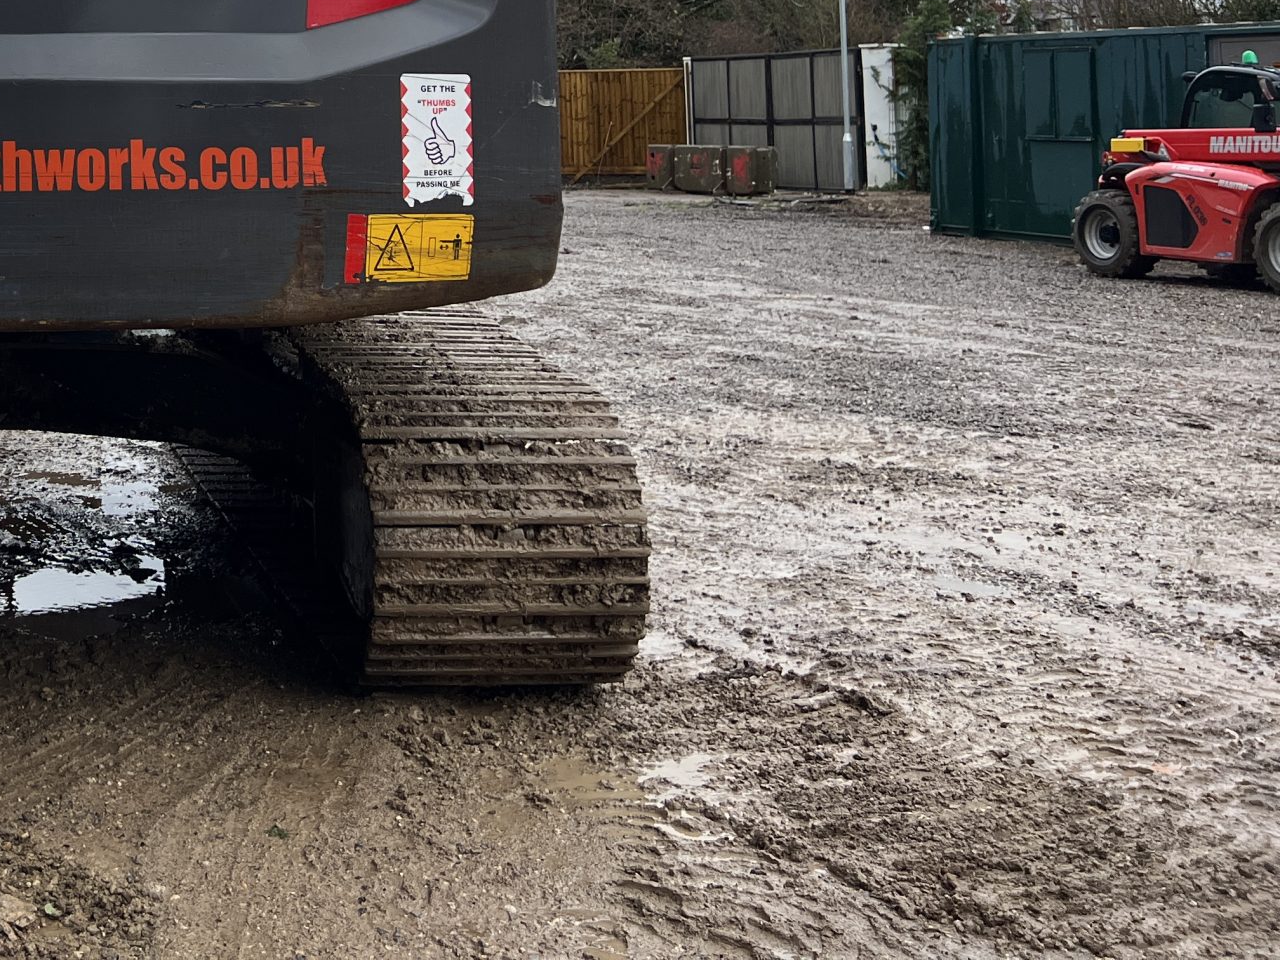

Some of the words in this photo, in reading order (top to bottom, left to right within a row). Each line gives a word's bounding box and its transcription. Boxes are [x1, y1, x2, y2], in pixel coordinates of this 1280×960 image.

[420, 85, 437, 93] GET
[417, 99, 456, 107] "THUMBS
[1209, 135, 1280, 154] MANITOU
[416, 180, 448, 188] PASSING
